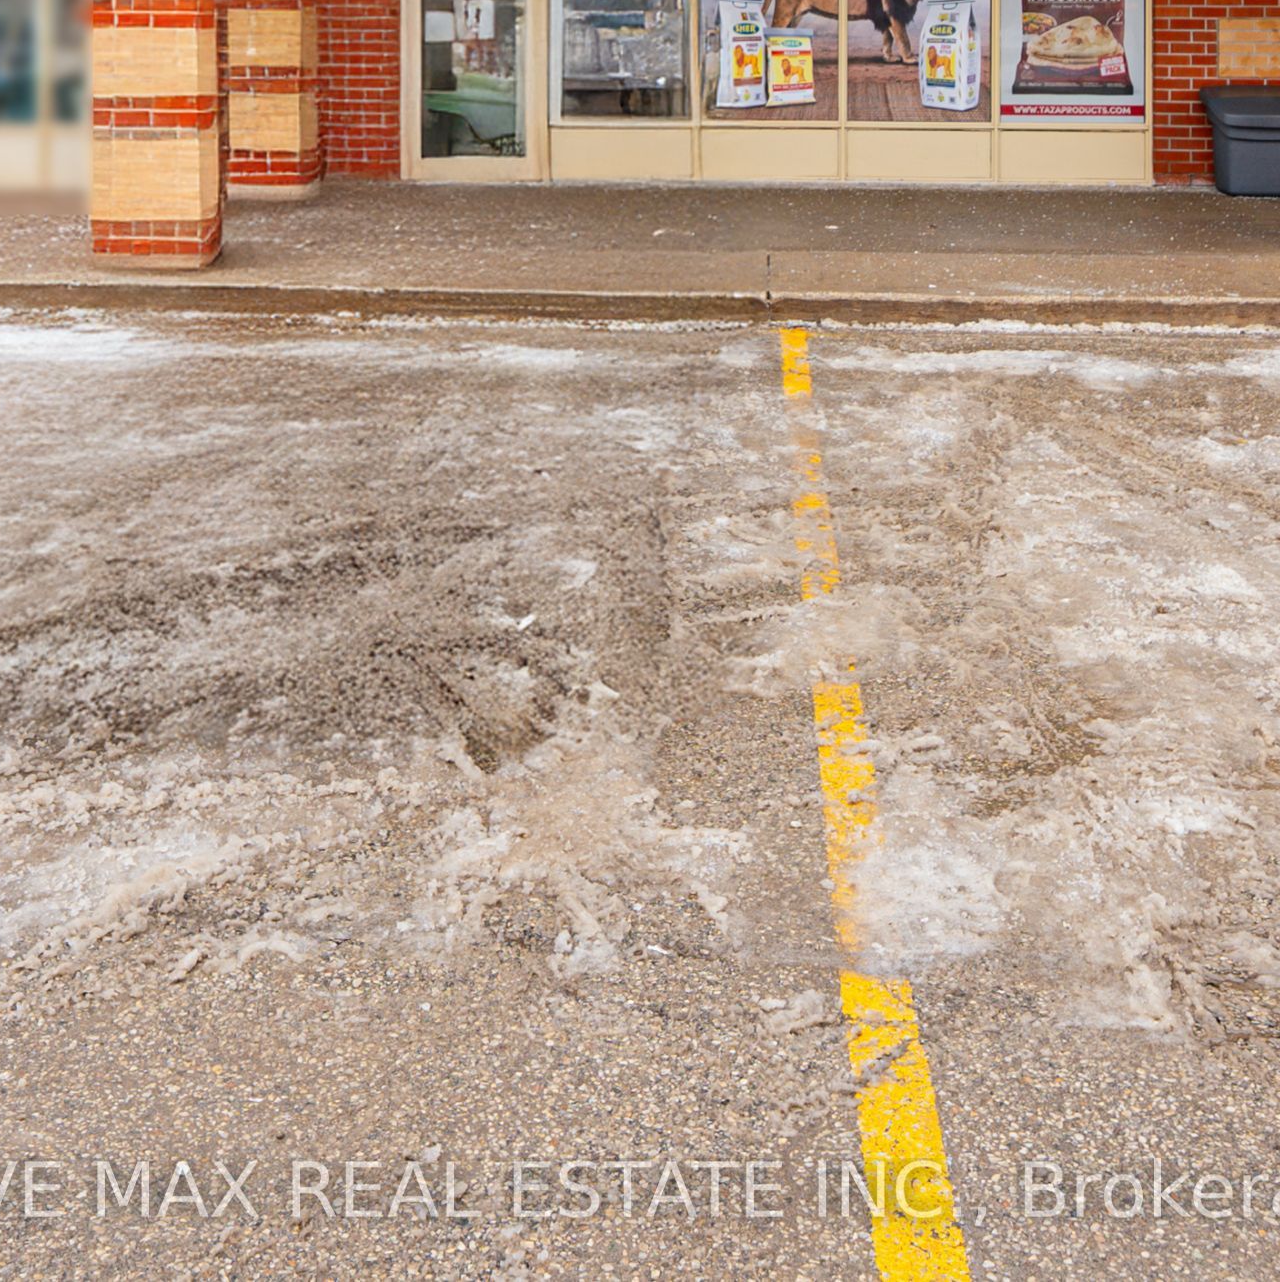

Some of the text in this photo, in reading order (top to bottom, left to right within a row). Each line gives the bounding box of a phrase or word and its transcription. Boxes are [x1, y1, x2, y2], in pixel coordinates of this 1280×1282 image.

[735, 23, 756, 33] SHER
[931, 25, 953, 35] SHER
[1013, 105, 1131, 115] WWW.TAZAPRODUCTS.COM
